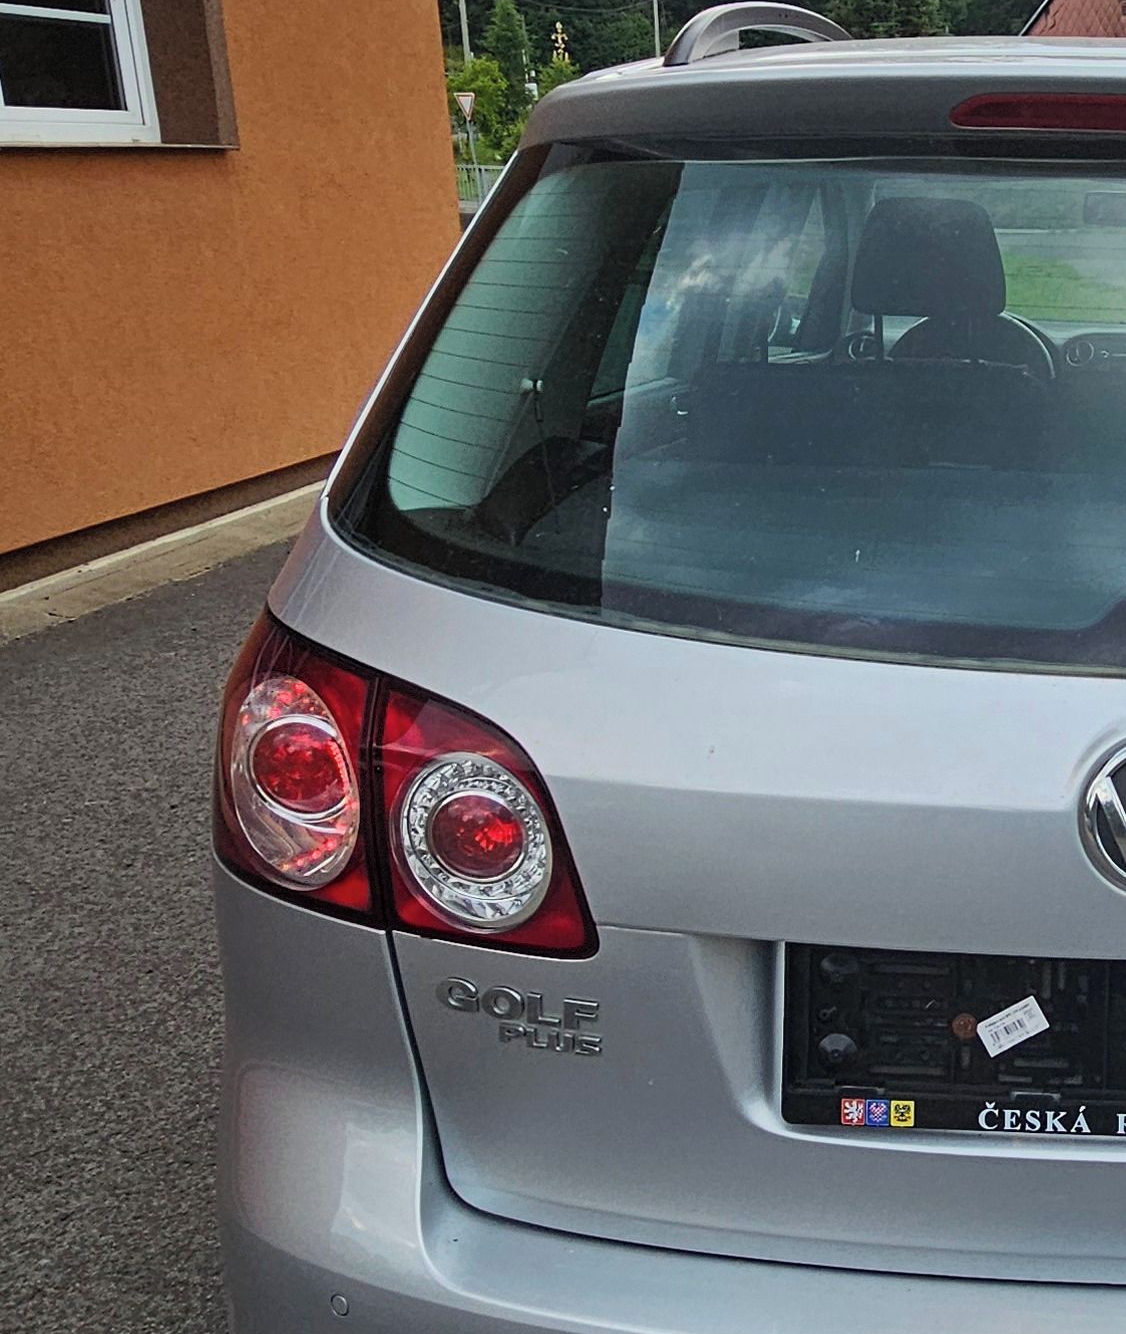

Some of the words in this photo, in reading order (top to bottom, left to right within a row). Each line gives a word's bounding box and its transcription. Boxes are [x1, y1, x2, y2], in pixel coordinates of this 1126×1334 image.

[436, 976, 600, 1030] GOLF
[499, 1020, 602, 1056] PLUS
[978, 1102, 1092, 1134] ČESKÁ
